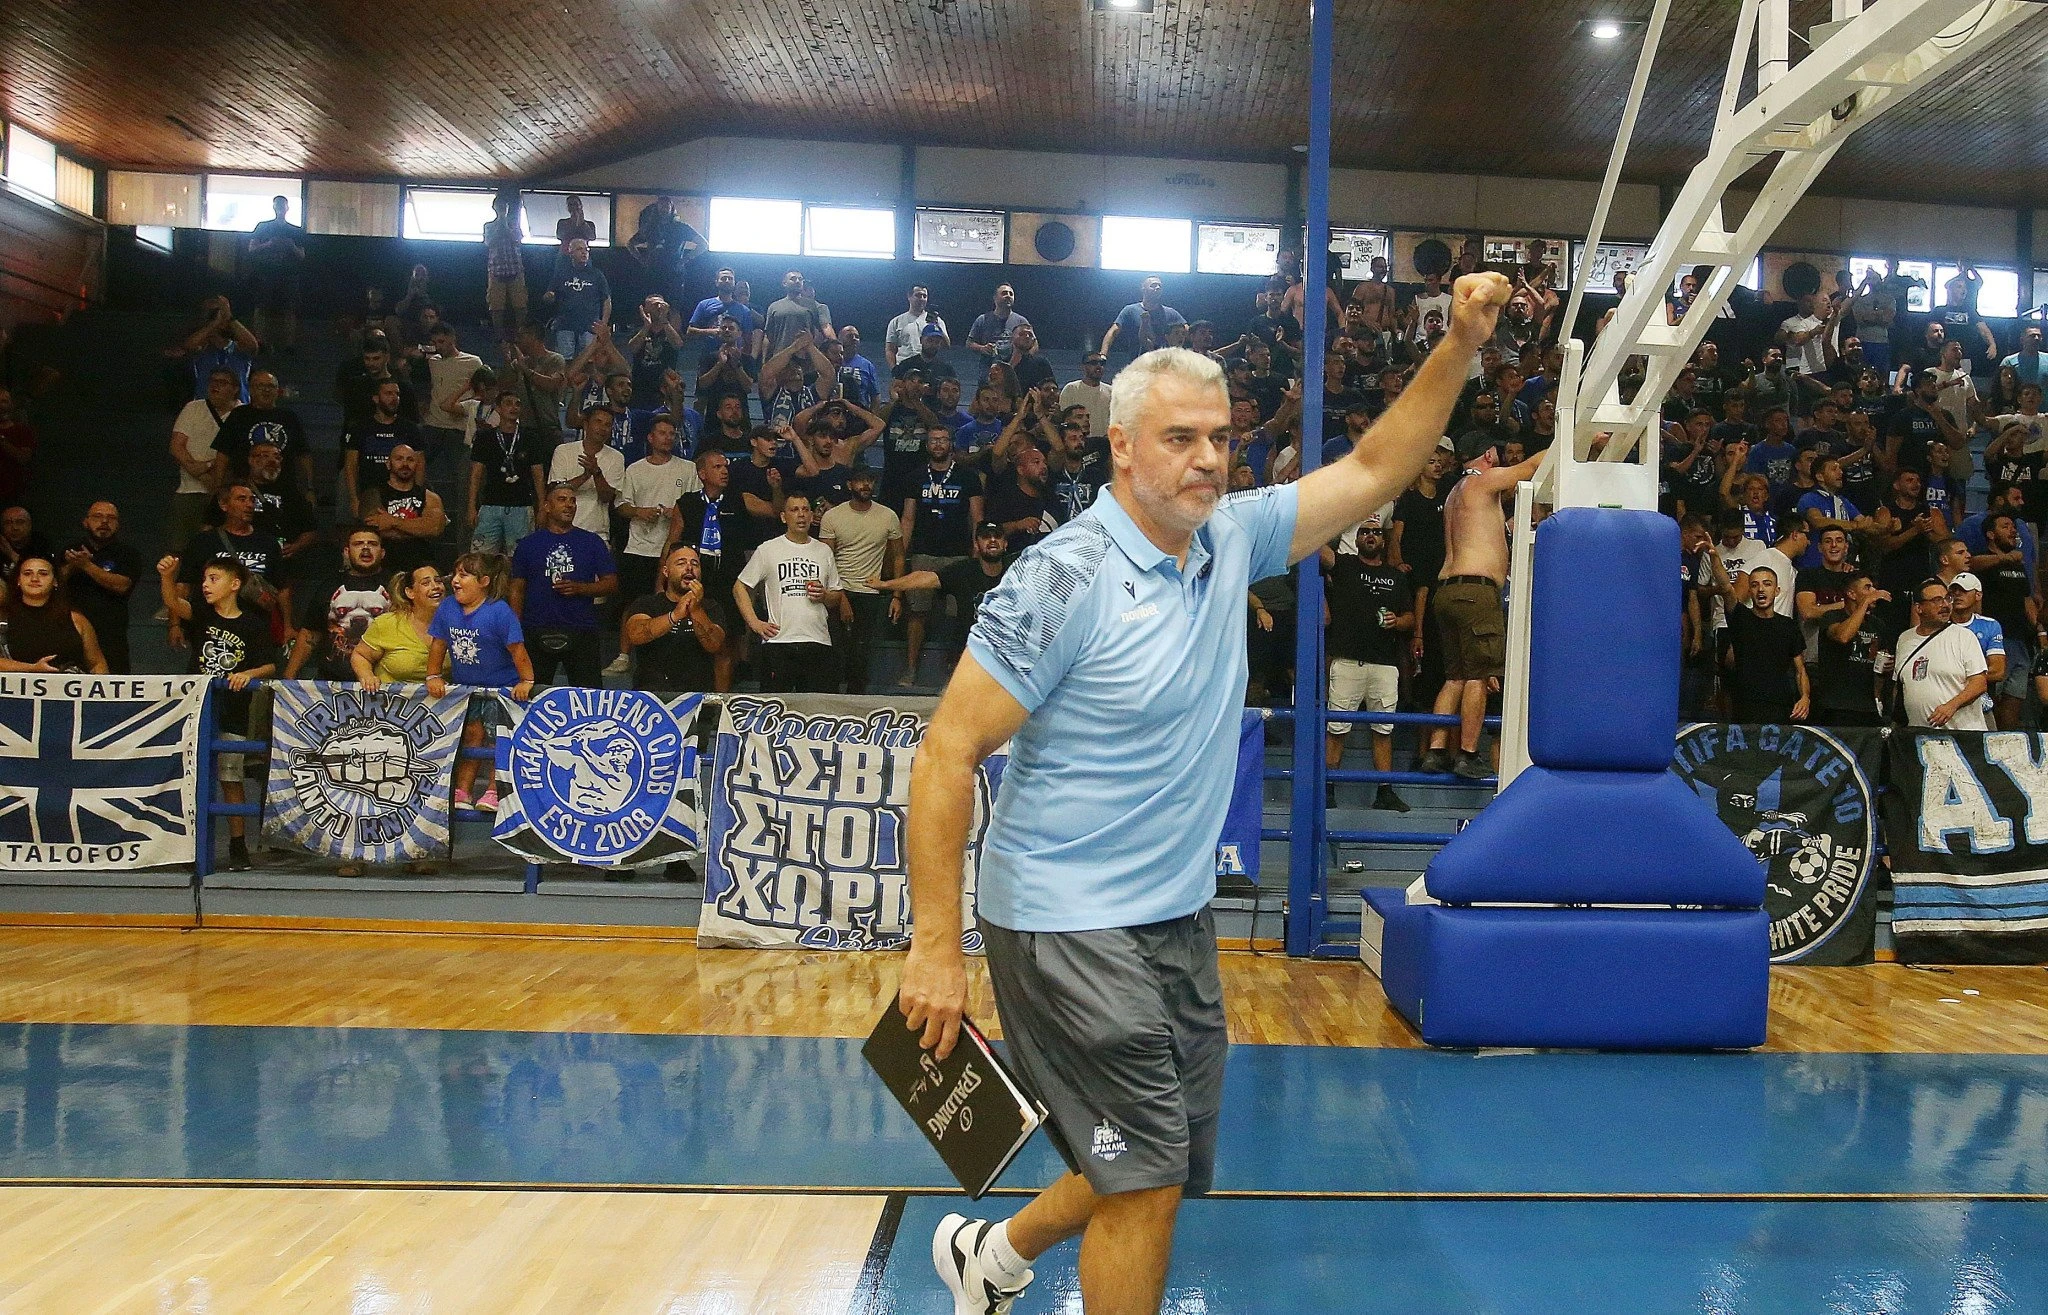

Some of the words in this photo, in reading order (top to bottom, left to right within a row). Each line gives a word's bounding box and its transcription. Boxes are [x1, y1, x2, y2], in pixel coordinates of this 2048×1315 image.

[1120, 602, 1160, 623] novibet
[222, 630, 246, 650] RIDE
[0, 676, 48, 697] LIS
[64, 680, 146, 698] GATE
[296, 691, 445, 748] IRAKLIS
[568, 688, 663, 736] ATHENS
[646, 733, 676, 795] CLUB
[728, 697, 928, 748] Ηρακλή
[1673, 723, 1749, 774] TIFA
[1758, 723, 1849, 788] GATE
[290, 769, 351, 838] ANTI
[537, 804, 587, 850] EST.
[593, 808, 655, 852] 2008
[9, 842, 141, 864] TALOFOS
[1768, 904, 1823, 951] HITE
[1811, 845, 1862, 918] PRIDE
[926, 1062, 982, 1141] SPALDING
